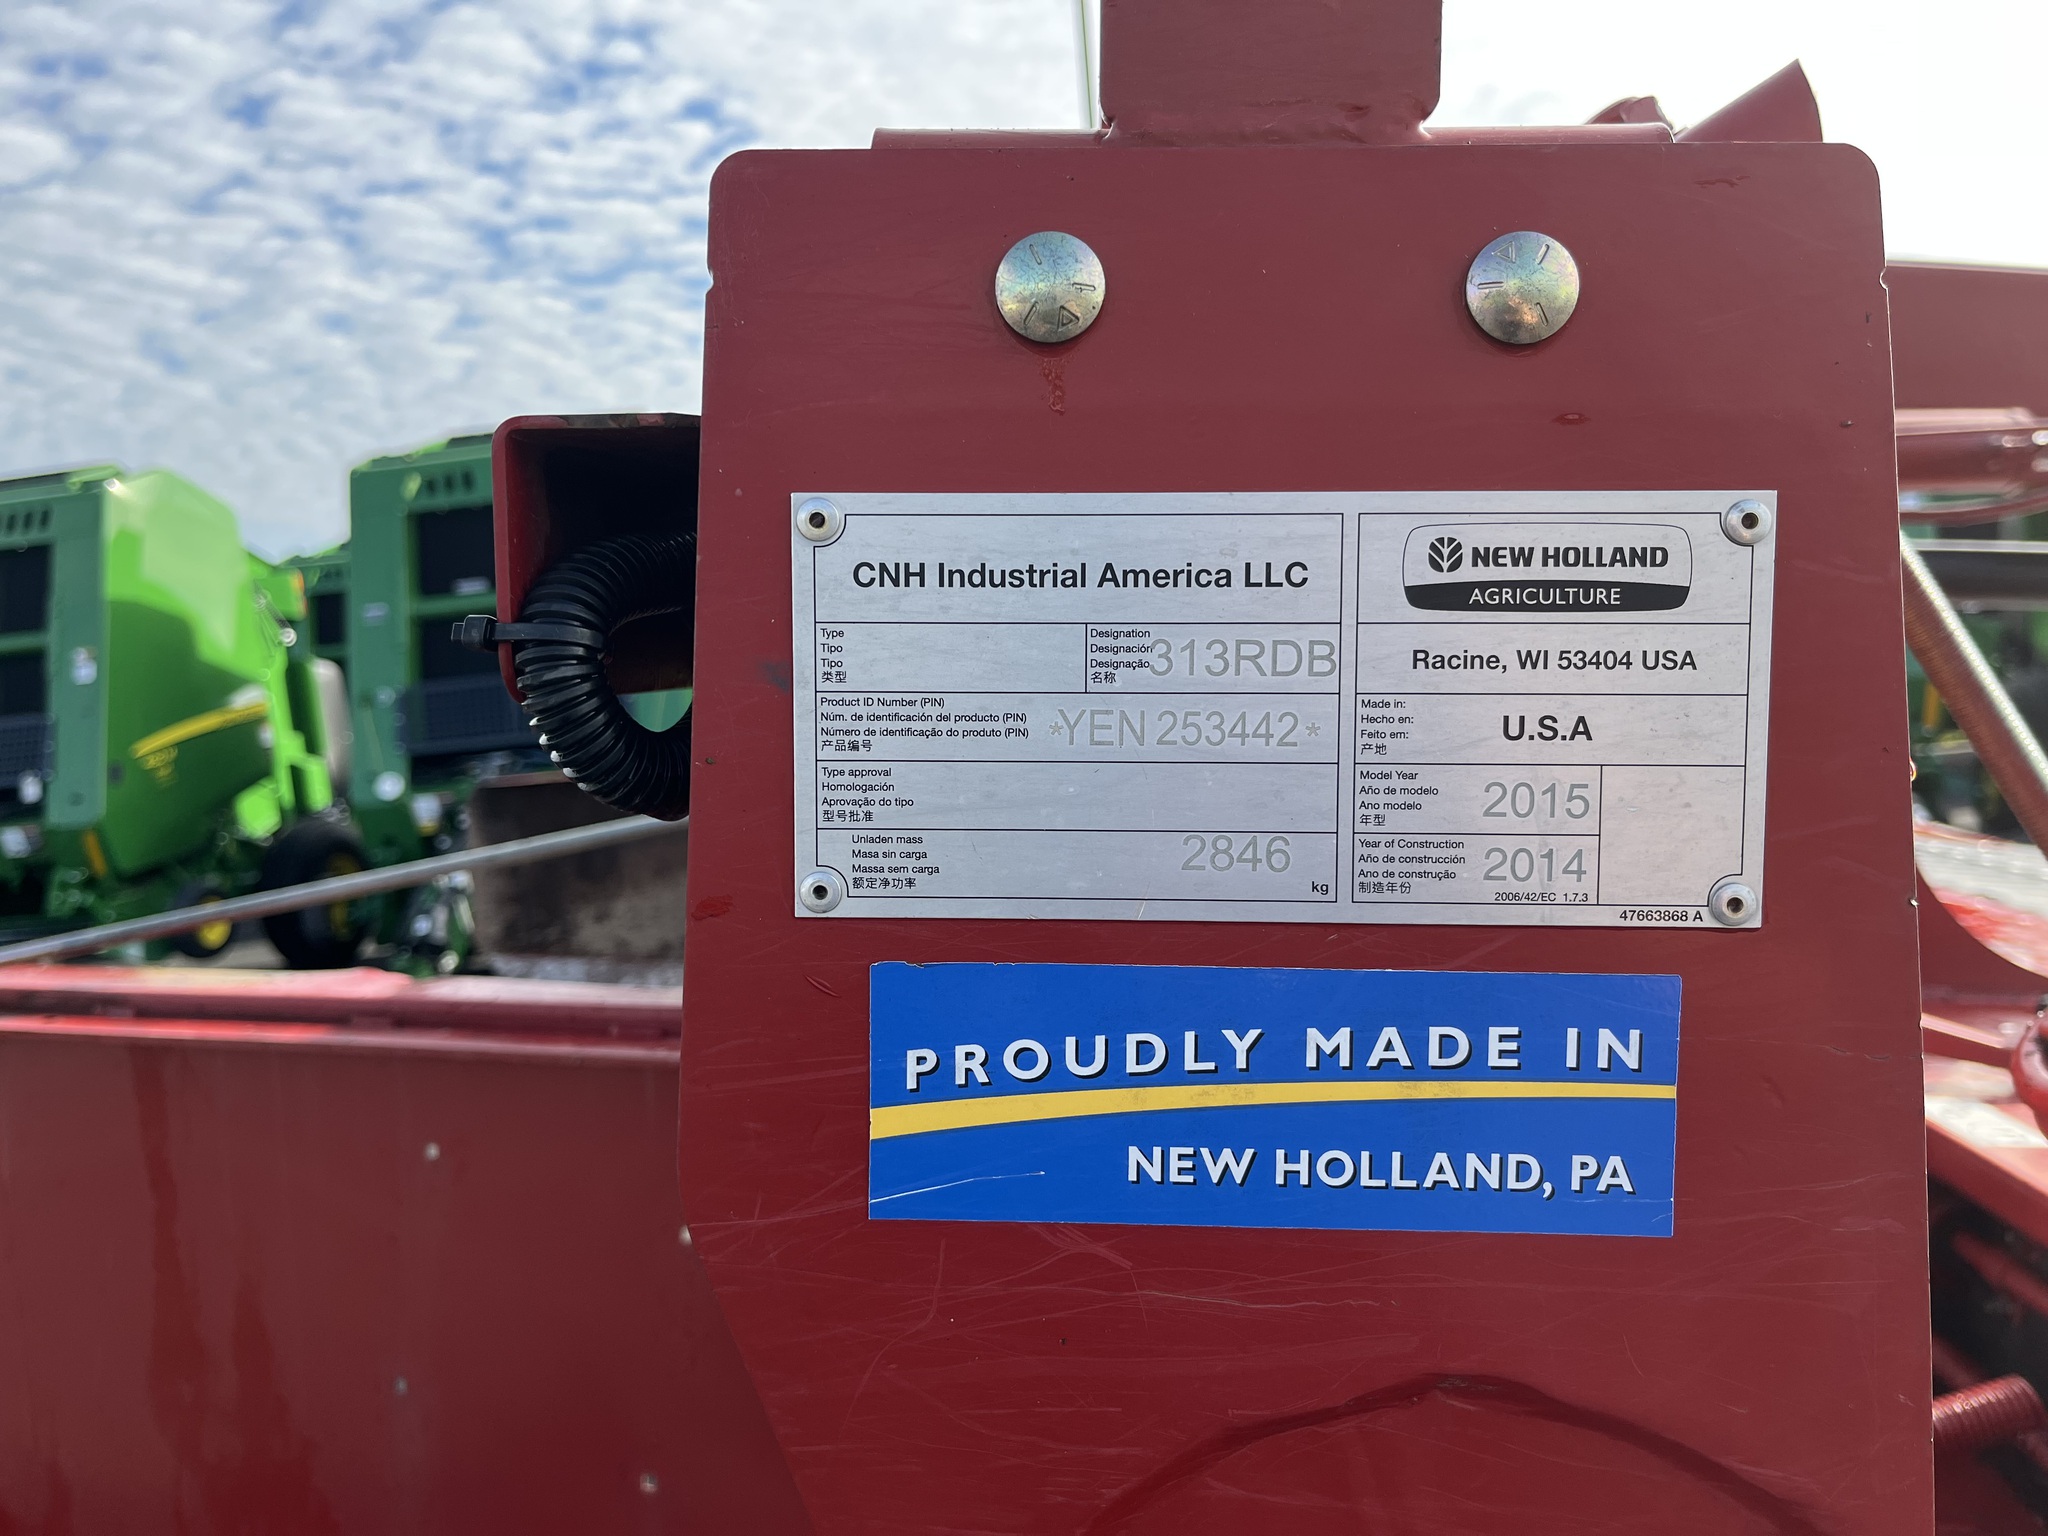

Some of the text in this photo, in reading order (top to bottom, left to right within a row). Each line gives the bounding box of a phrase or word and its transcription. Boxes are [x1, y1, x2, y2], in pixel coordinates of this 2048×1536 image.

[1472, 547, 1668, 567] NEW HOLLAND
[852, 562, 1309, 588] CNH Industrial America LLC
[1469, 588, 1621, 605] AGRICULTURE
[821, 628, 844, 639] Type
[1090, 629, 1150, 639] Designation
[821, 644, 843, 654] Tipo
[1090, 644, 1152, 654] Designación
[1150, 638, 1336, 677] 313RDB
[1412, 649, 1697, 673] Racine, WI 53404 USA
[821, 659, 843, 669] Tipo
[1090, 659, 1150, 670] Designação
[822, 671, 847, 683] 类型
[1090, 672, 1116, 684] 名称
[821, 698, 944, 708] Product ID Number (PIN)
[1361, 700, 1406, 708] Made in:
[821, 712, 1027, 725] Núm. de identificación del producto (PIN)
[1361, 715, 1414, 724] Hecho en:
[821, 727, 1028, 740] Número de identificação do produto (PIN)
[1503, 715, 1593, 741] U.S.A
[1361, 730, 1386, 739] Feito
[822, 740, 872, 752] 产品编号
[1361, 743, 1387, 755] 产地
[822, 768, 891, 778] Type approval
[1360, 771, 1418, 780] Model Year
[822, 782, 894, 793] Homologación
[1359, 786, 1438, 795] Año de modelo
[822, 797, 914, 808] Aprovação do tipo
[1359, 801, 1422, 810] Ano modelo
[1483, 782, 1590, 819] 2015
[822, 810, 874, 822] 型号批准
[1360, 814, 1386, 827] 年型
[852, 835, 893, 844] Unladen
[1359, 839, 1464, 849] Year of Construction
[852, 850, 927, 861] Masa sin carga
[1182, 834, 1292, 872] 2846
[1358, 854, 1465, 864] Año de construcción
[852, 865, 940, 876] Massa sem carga
[1483, 848, 1587, 883] 2014
[1358, 870, 1456, 881] Ano de construção
[852, 877, 916, 889] 额定净功率
[1311, 881, 1329, 896] kg
[1358, 882, 1411, 894] 制造年份
[1494, 892, 1588, 902] 2006/42/EC 1.7.3
[1620, 910, 1703, 922] 47663868 A
[905, 1026, 1644, 1093] PROUDLY MADE IN
[1127, 1145, 1635, 1200] NEW HOLLAND, PA
